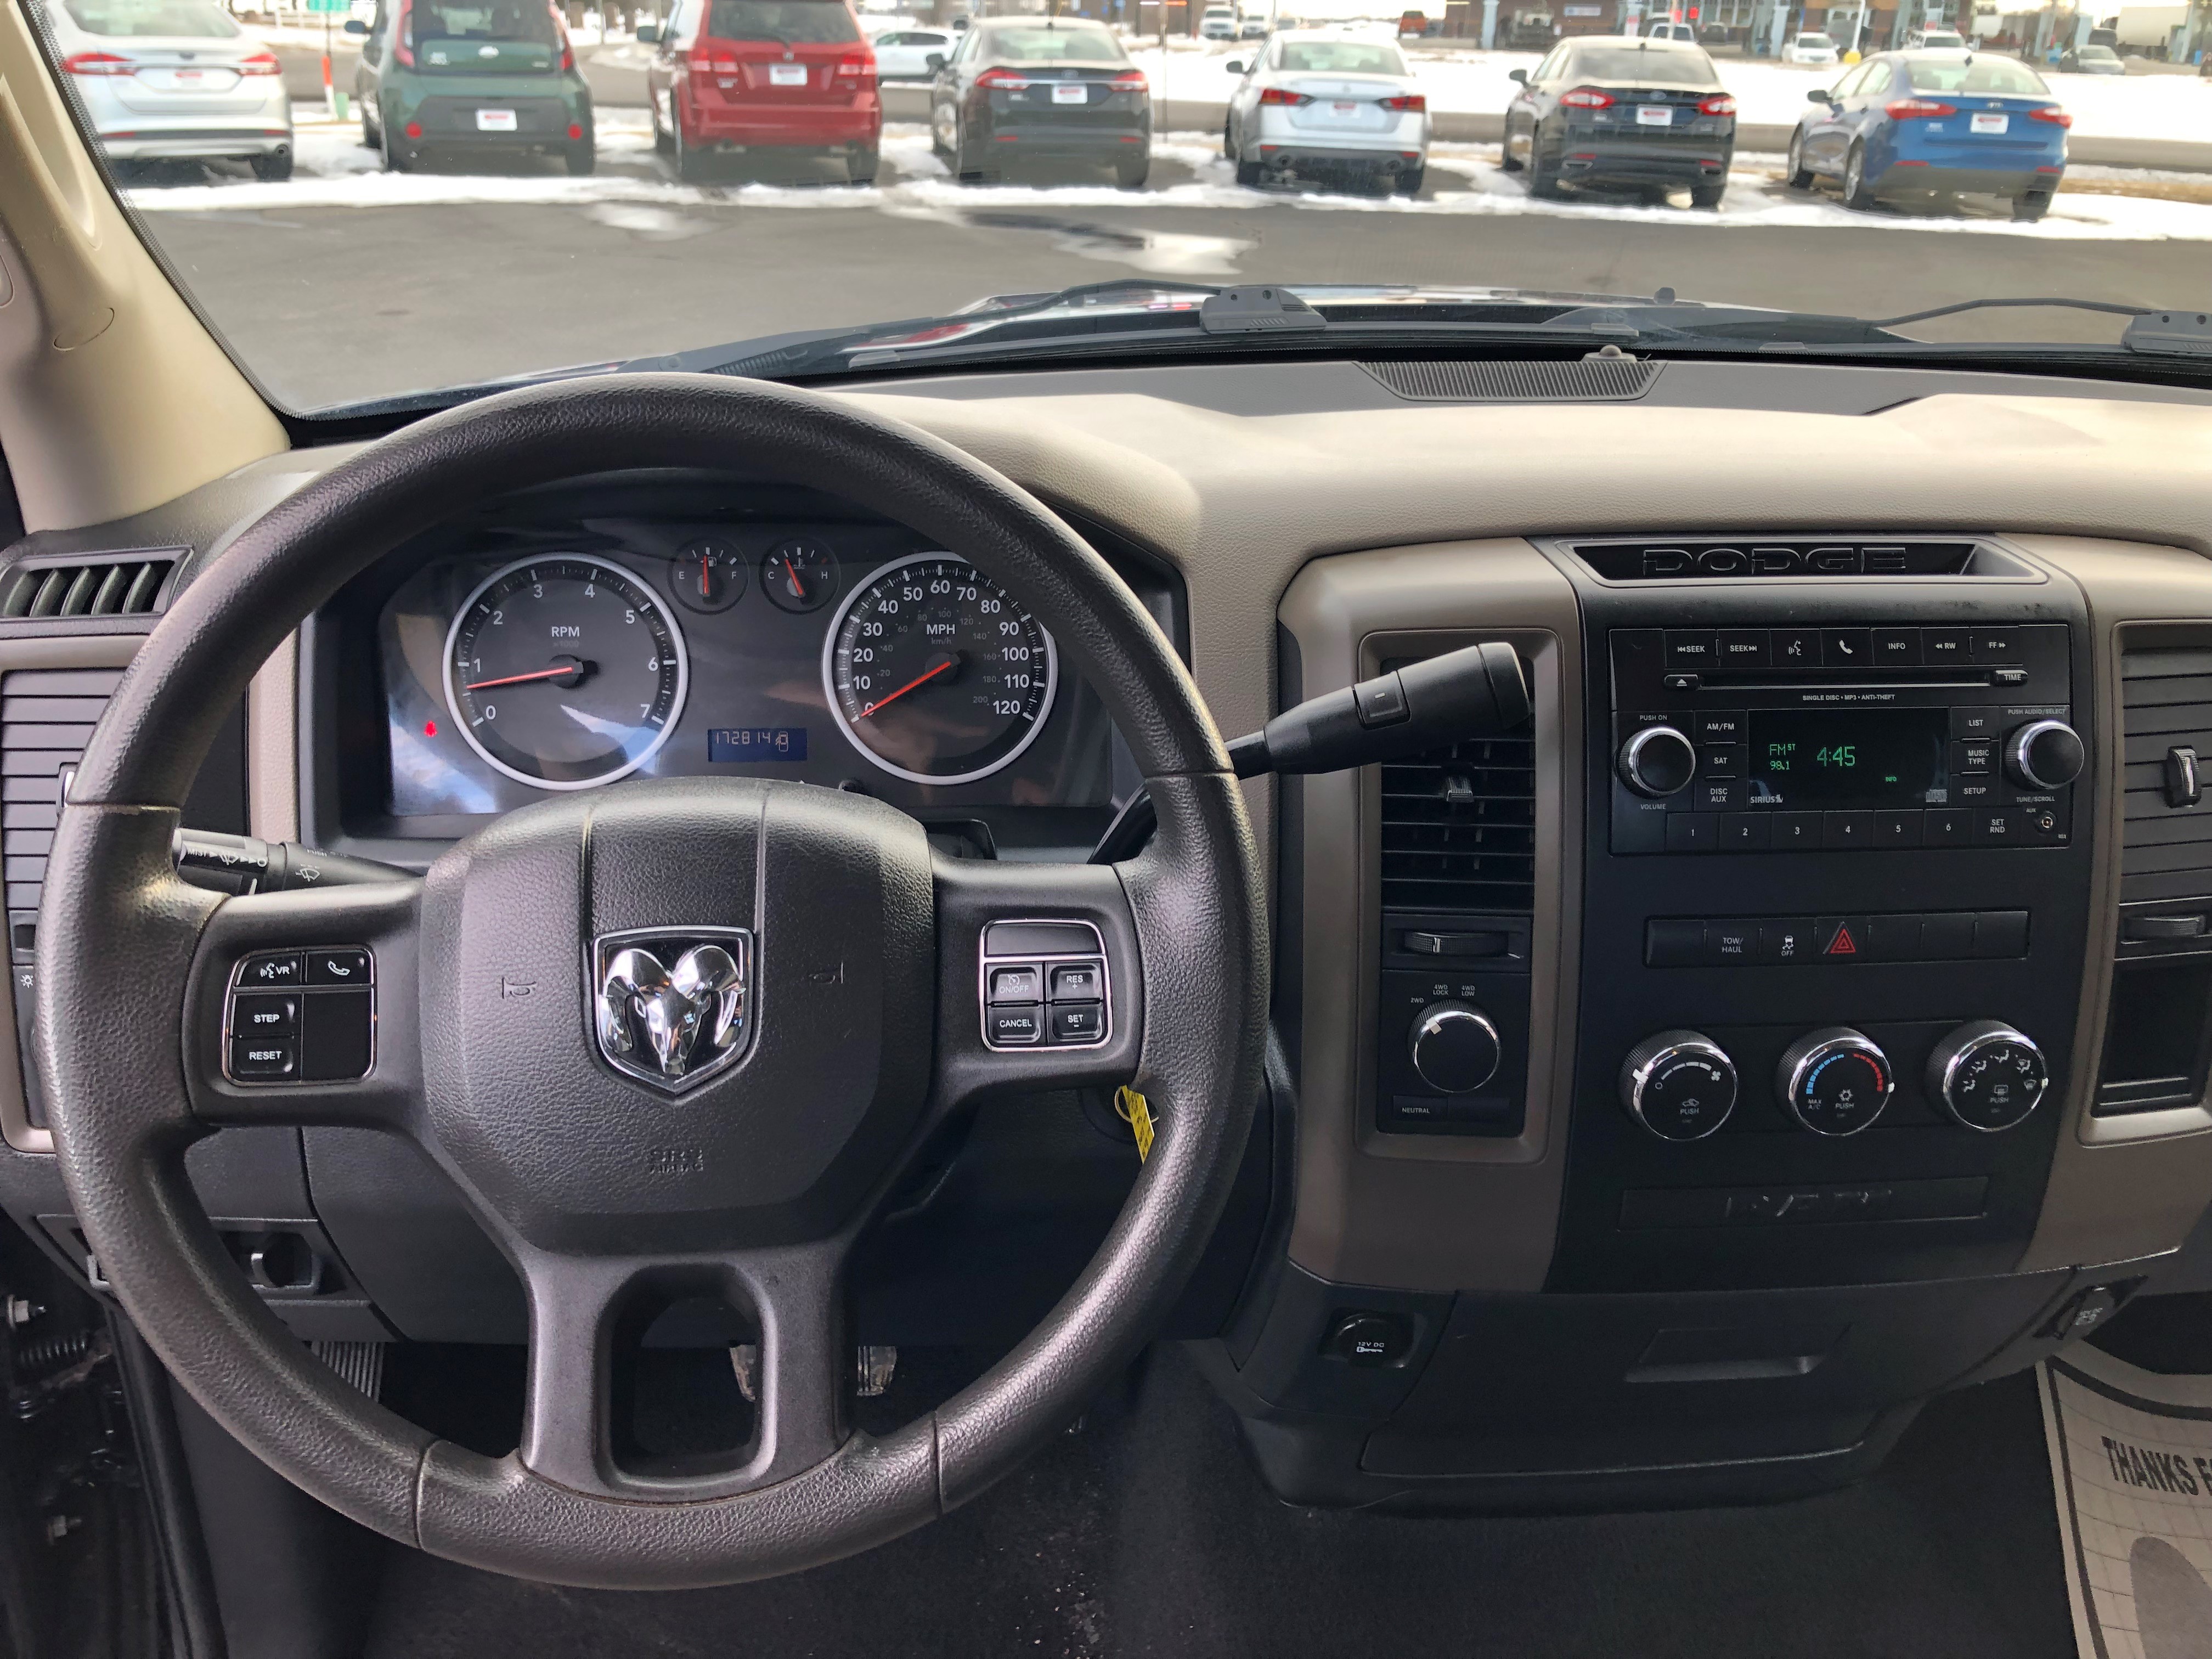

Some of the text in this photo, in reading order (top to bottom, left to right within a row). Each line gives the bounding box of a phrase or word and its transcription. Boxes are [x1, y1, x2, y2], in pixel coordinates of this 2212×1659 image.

[1643, 548, 1906, 575] DODGE
[534, 585, 543, 598] 3
[585, 584, 595, 597] 4
[903, 587, 923, 601] 50
[930, 580, 950, 594] 60
[956, 586, 977, 601] 70
[878, 600, 899, 614] 40
[981, 600, 1001, 613] 80
[493, 611, 503, 625] 2
[626, 610, 635, 624] 5
[551, 627, 580, 637] RPM
[863, 622, 883, 636] 30
[927, 624, 955, 635] MPH
[1000, 622, 1019, 636] 90
[854, 648, 873, 662] 20
[1002, 647, 1029, 661] 100
[473, 659, 481, 673] 1
[648, 657, 658, 671] 6
[853, 676, 871, 690] 10
[1005, 674, 1029, 689] 110
[486, 705, 496, 719] 0
[641, 704, 650, 718] 7
[992, 701, 1020, 714] 120
[1707, 723, 1735, 731] AM/FM
[1770, 744, 1786, 755] FM
[1817, 747, 1855, 766] 4:45
[1722, 945, 1742, 953] HAUL
[276, 966, 290, 975] VR
[1066, 975, 1084, 983] RES
[999, 985, 1029, 994] ON/OFF
[254, 1014, 280, 1023] STEP
[999, 1019, 1032, 1028] CANCEL
[1068, 1014, 1084, 1023] SET
[249, 1051, 282, 1060] RESET
[2101, 1435, 2212, 1497] THANKS F
